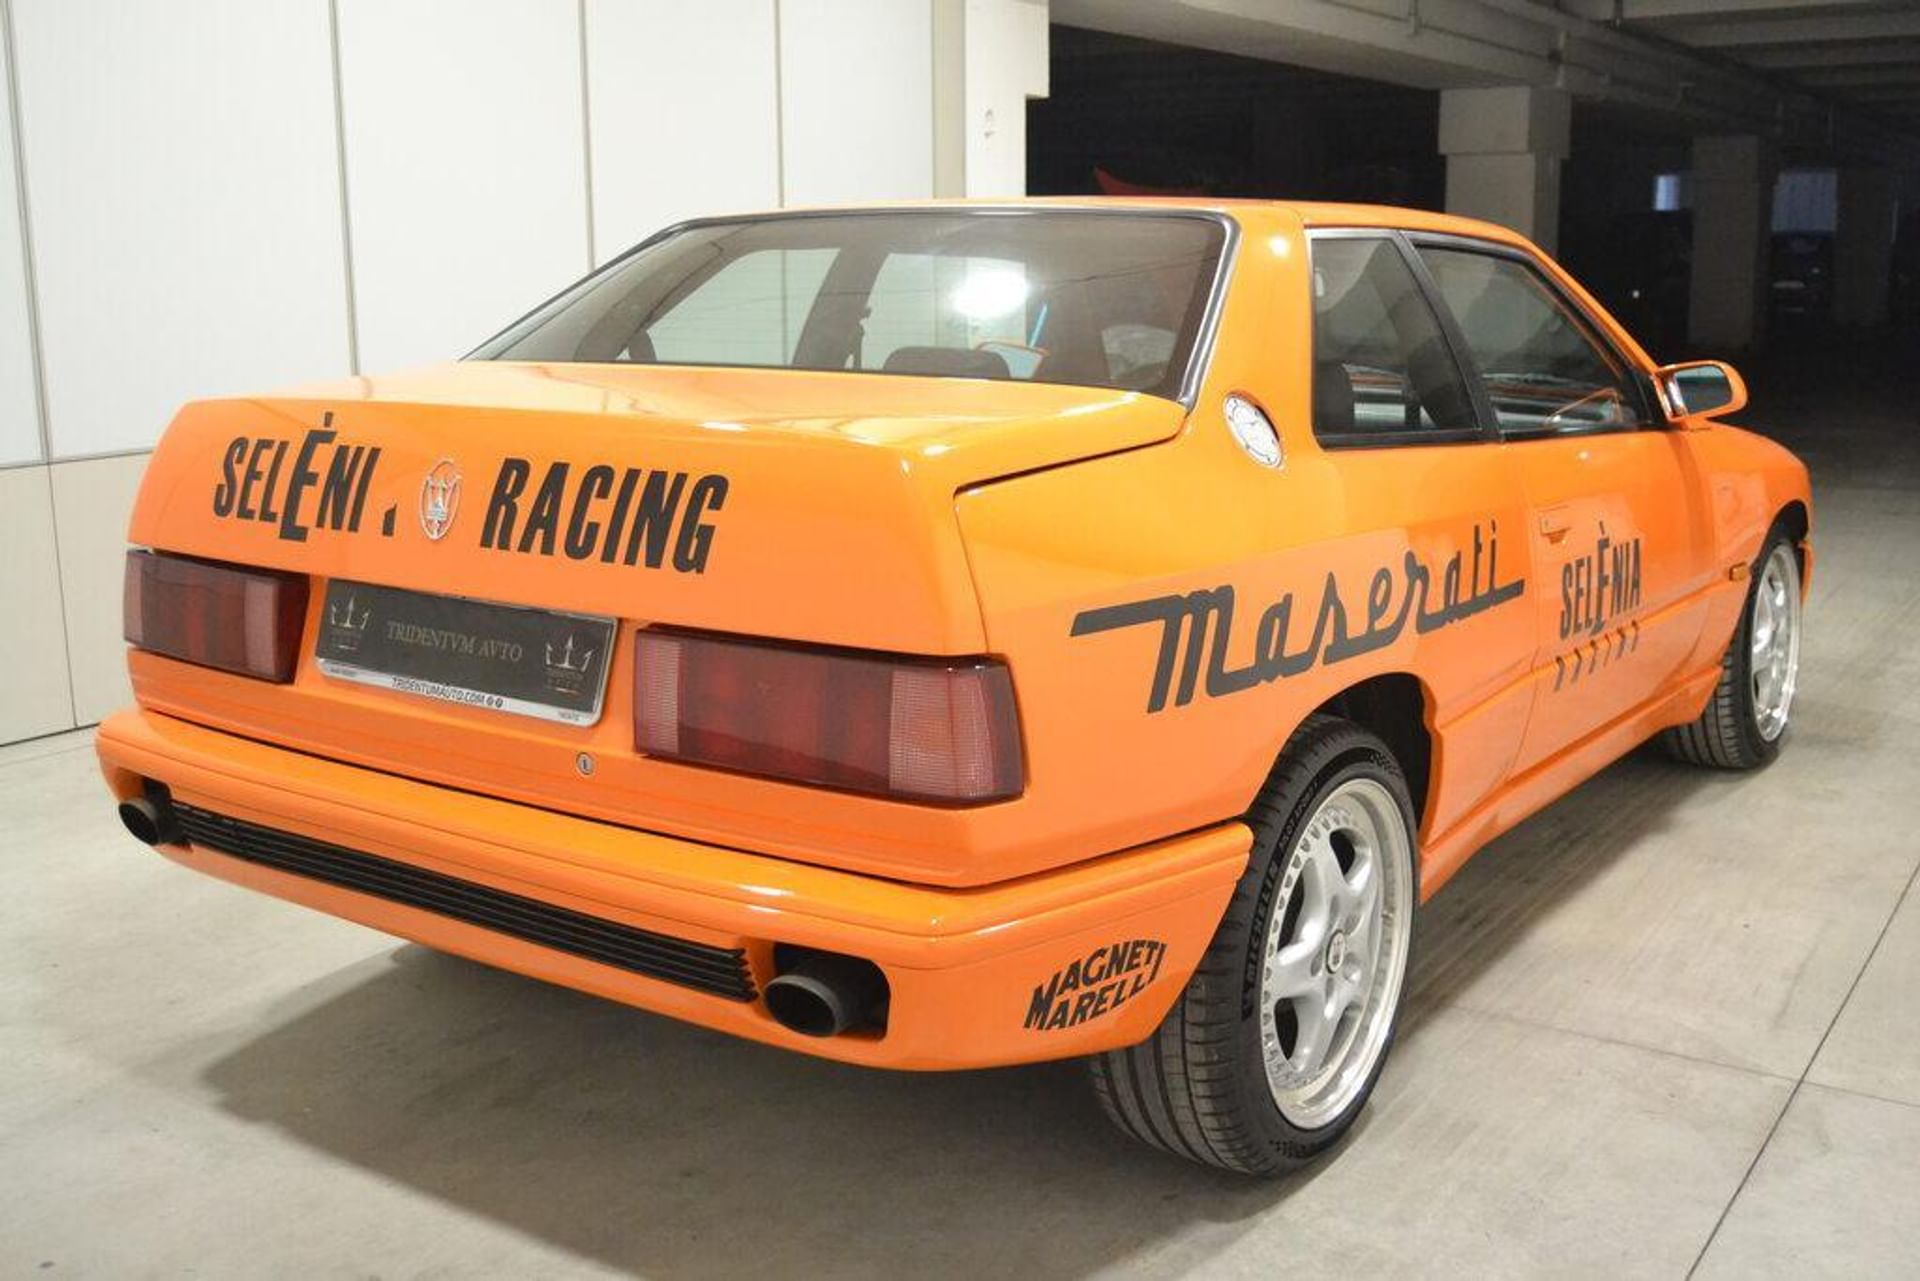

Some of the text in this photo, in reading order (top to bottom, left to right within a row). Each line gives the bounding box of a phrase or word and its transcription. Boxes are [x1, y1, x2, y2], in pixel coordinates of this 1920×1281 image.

[480, 457, 729, 574] RACING
[479, 638, 522, 661] AVTO
[1070, 519, 1525, 714] Maserati
[1023, 939, 1168, 1020] MAGNETI
